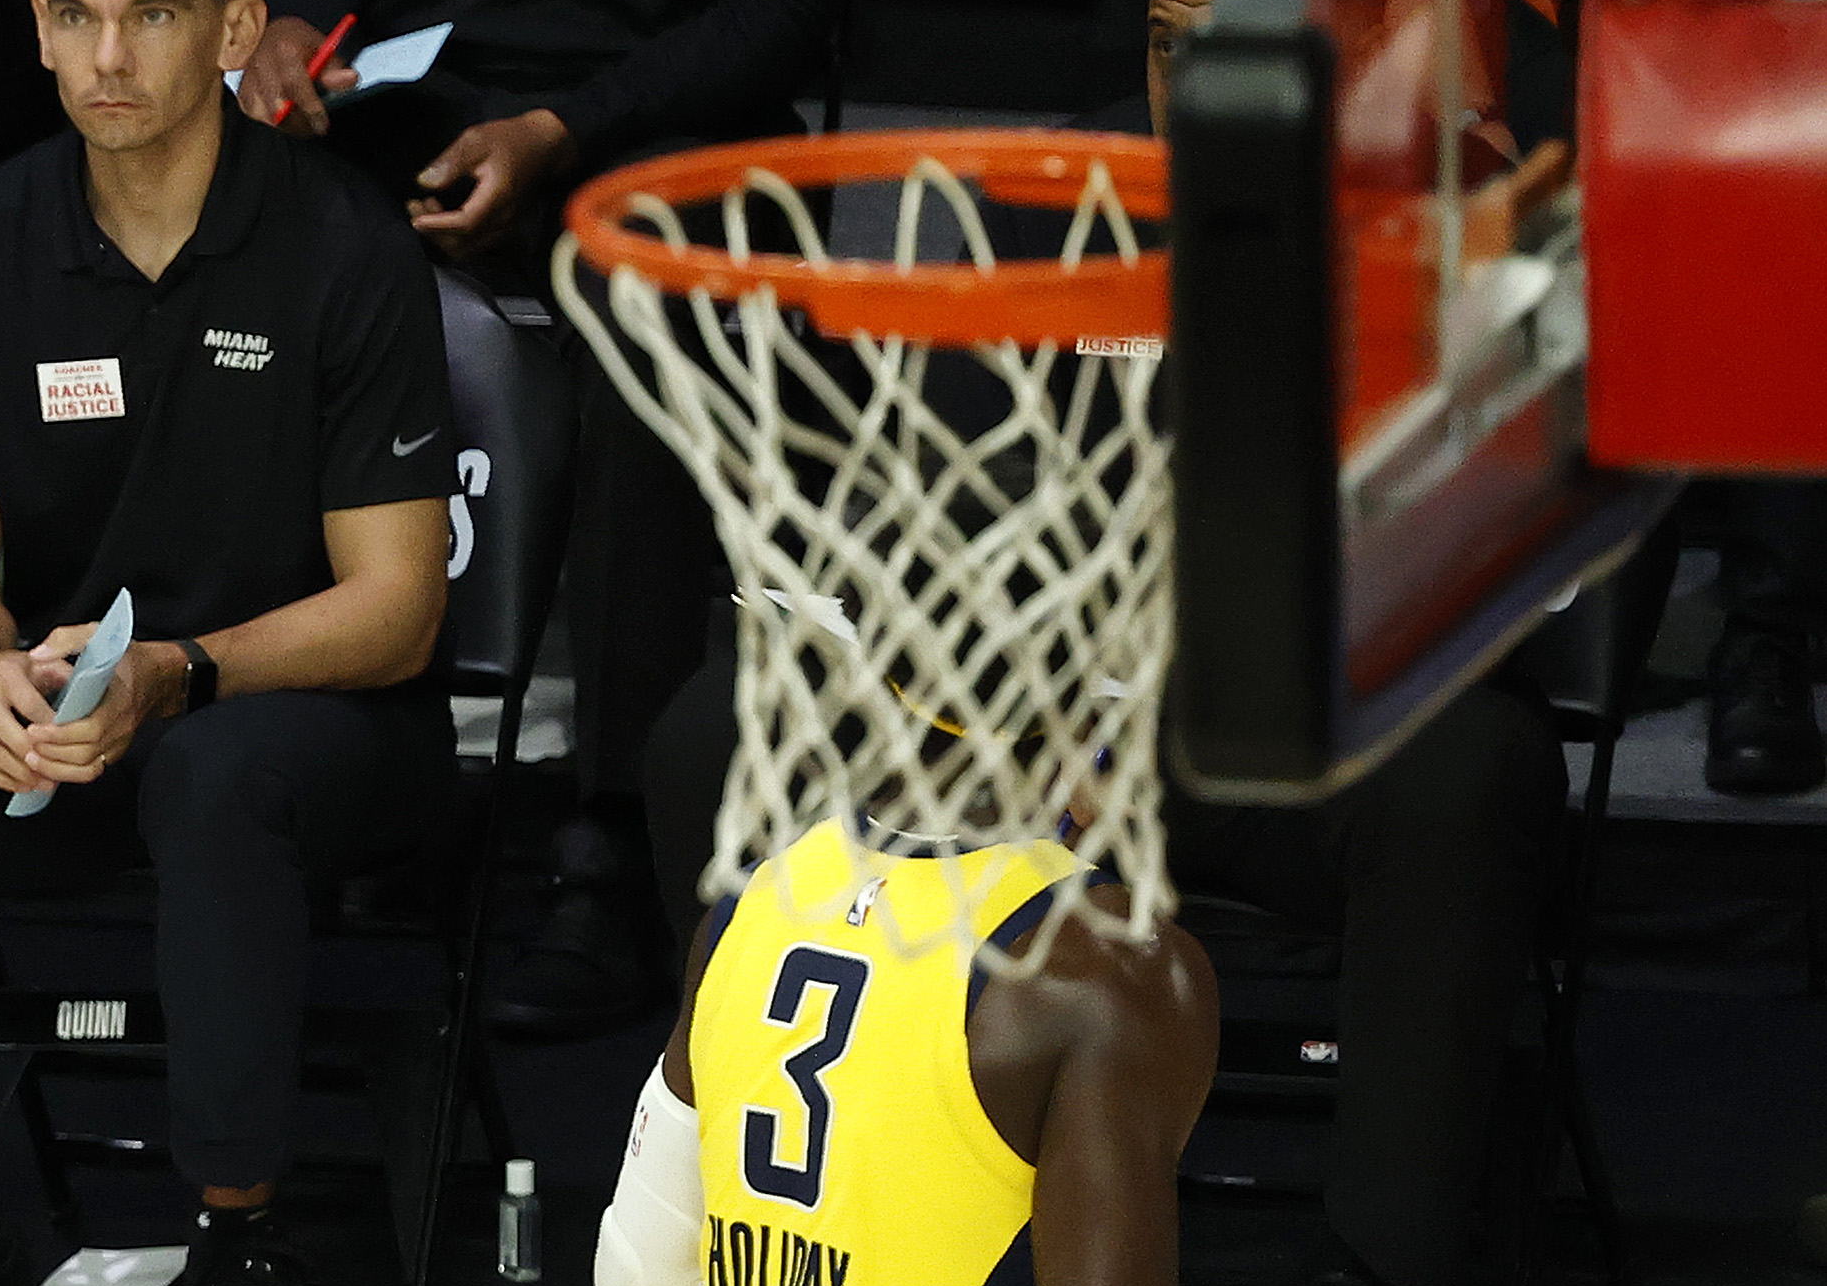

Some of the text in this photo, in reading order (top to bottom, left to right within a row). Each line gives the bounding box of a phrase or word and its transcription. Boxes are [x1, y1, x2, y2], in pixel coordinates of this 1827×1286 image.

[47, 381, 116, 399] RACIAL
[47, 398, 121, 417] JUSTICE
[55, 1000, 126, 1040] QUINN
[741, 941, 873, 1214] 3
